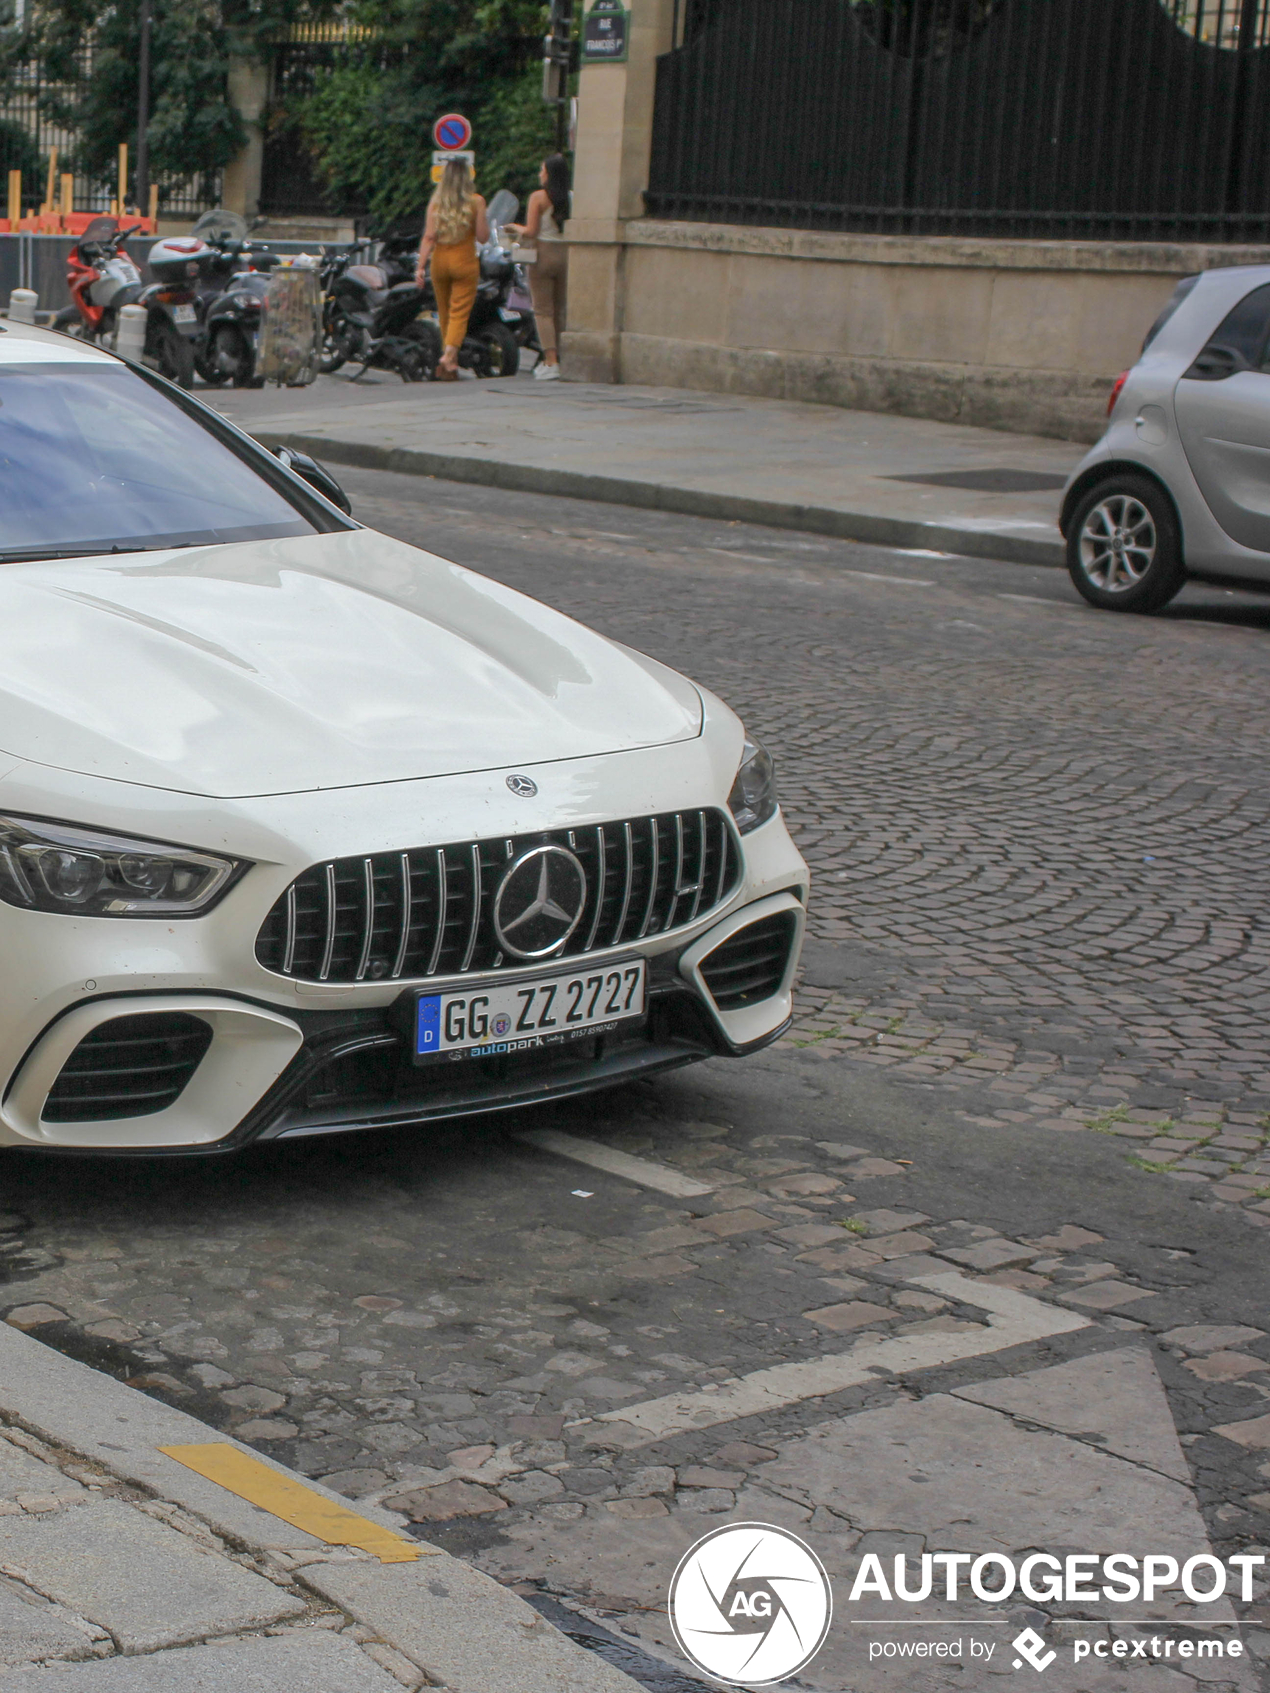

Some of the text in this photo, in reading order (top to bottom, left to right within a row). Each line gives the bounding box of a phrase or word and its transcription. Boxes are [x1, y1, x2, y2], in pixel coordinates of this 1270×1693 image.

[599, 18, 612, 29] RUE
[444, 966, 641, 1043] GG ZZ 2727
[424, 1031, 433, 1044] D
[471, 1036, 544, 1057] autopark
